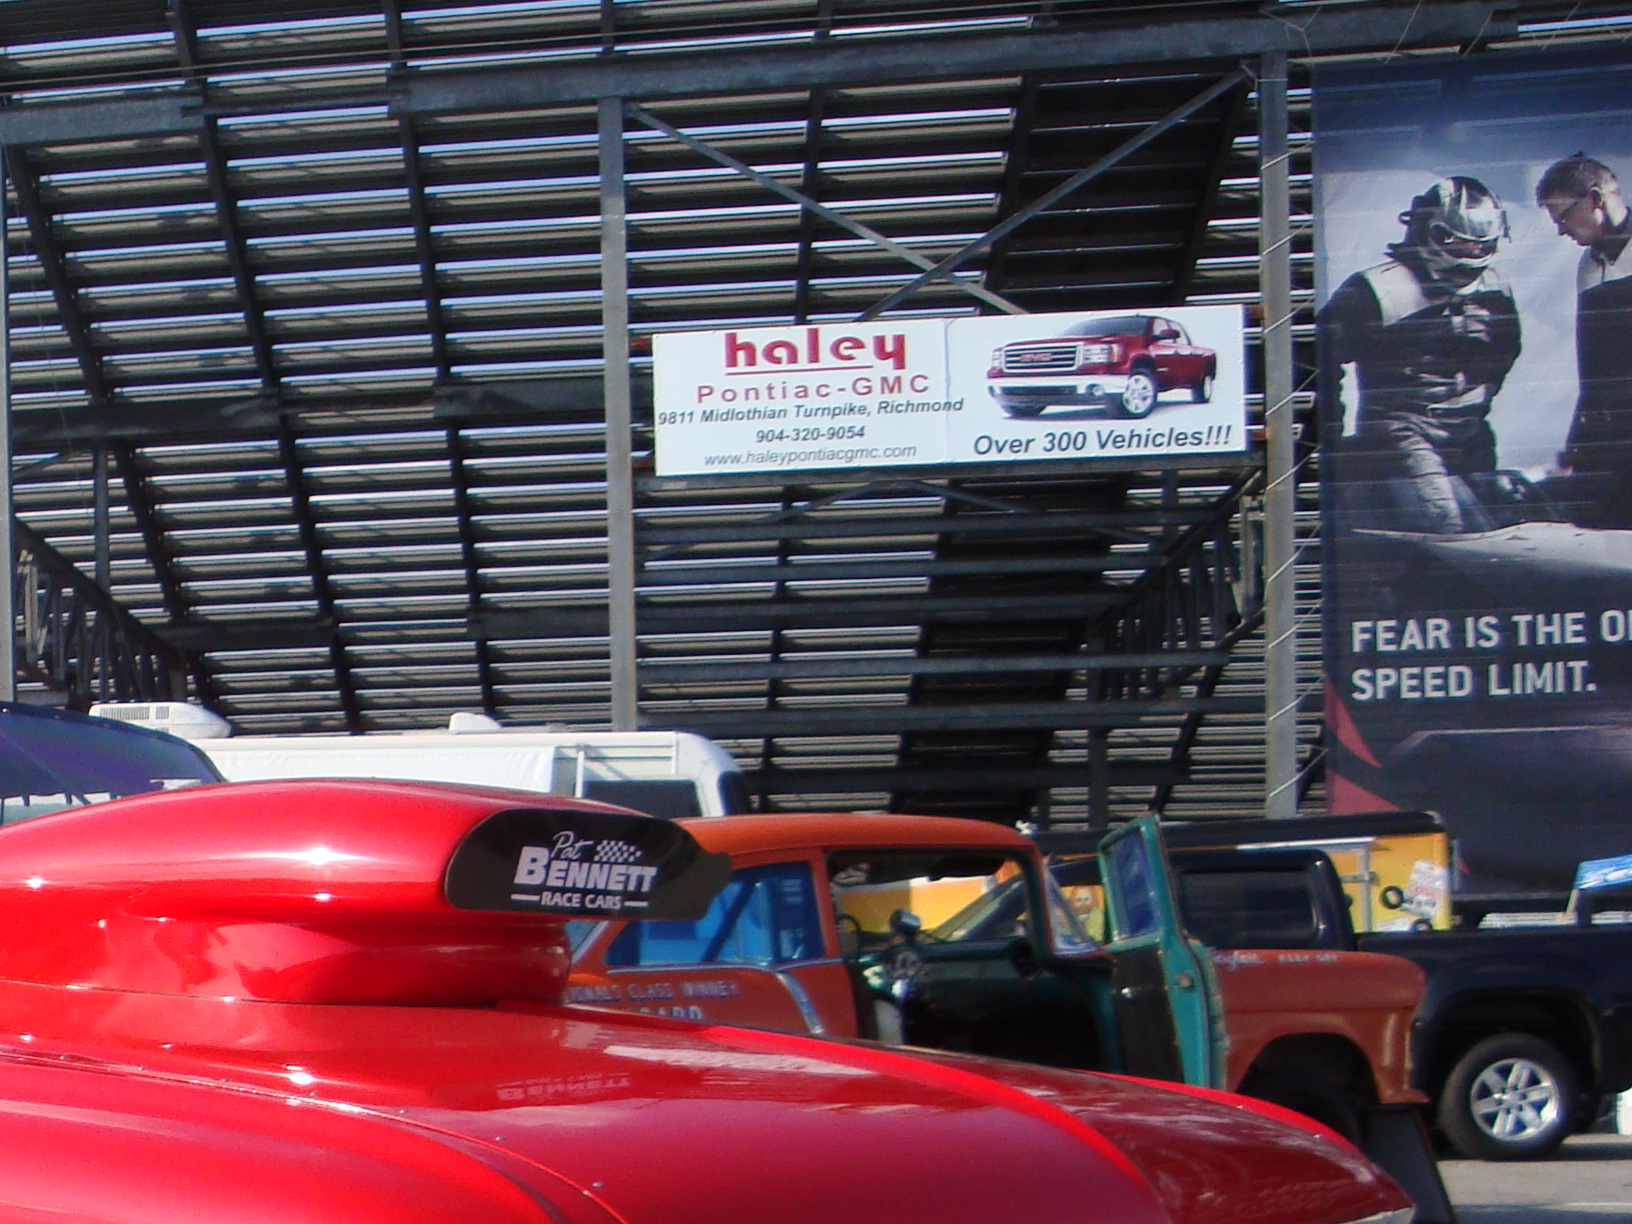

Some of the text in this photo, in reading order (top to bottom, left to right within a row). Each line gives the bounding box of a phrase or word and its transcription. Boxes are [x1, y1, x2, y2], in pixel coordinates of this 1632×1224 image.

[725, 328, 906, 370] haley
[697, 374, 930, 403] Pontiac-GMC
[658, 398, 965, 425] 9811 Midlothian Turnpike, Richmond
[973, 424, 1233, 455] Over 300 Vehicles!!!
[704, 445, 917, 466] www.haleypontiacgmc.com
[1351, 609, 1632, 652] FEAR IS THE O
[1351, 660, 1598, 701] SPEED LIMIT.
[551, 831, 594, 860] Pat
[513, 846, 658, 893] BENNETT
[541, 891, 622, 910] RACE CARS
